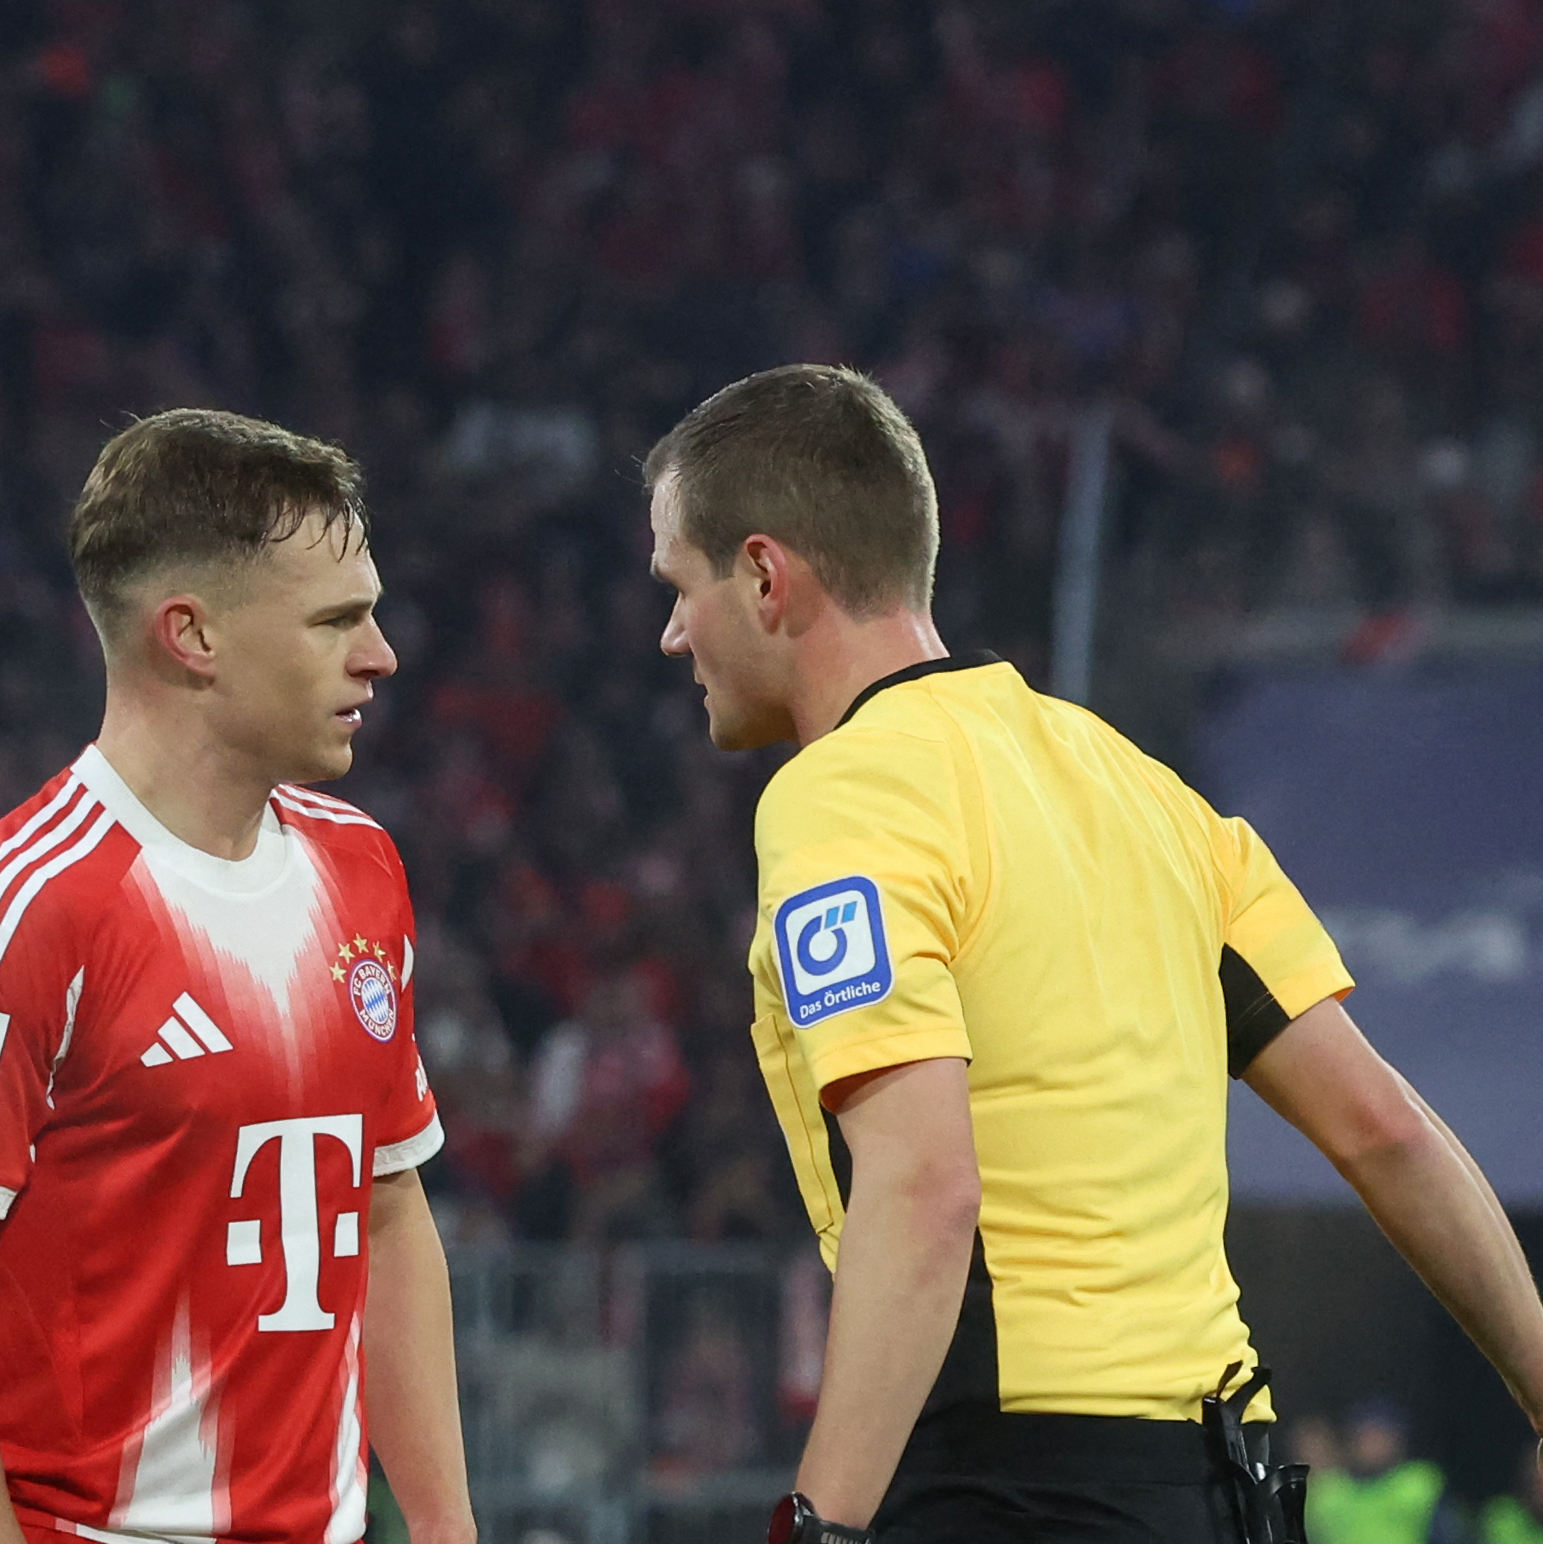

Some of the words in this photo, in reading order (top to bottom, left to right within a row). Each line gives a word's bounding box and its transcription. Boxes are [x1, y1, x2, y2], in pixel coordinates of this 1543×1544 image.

[353, 977, 362, 996] FC
[358, 965, 391, 995] BAYERN
[799, 1000, 822, 1019] Das
[823, 981, 881, 1007] Örtliche
[229, 1113, 364, 1332] T
